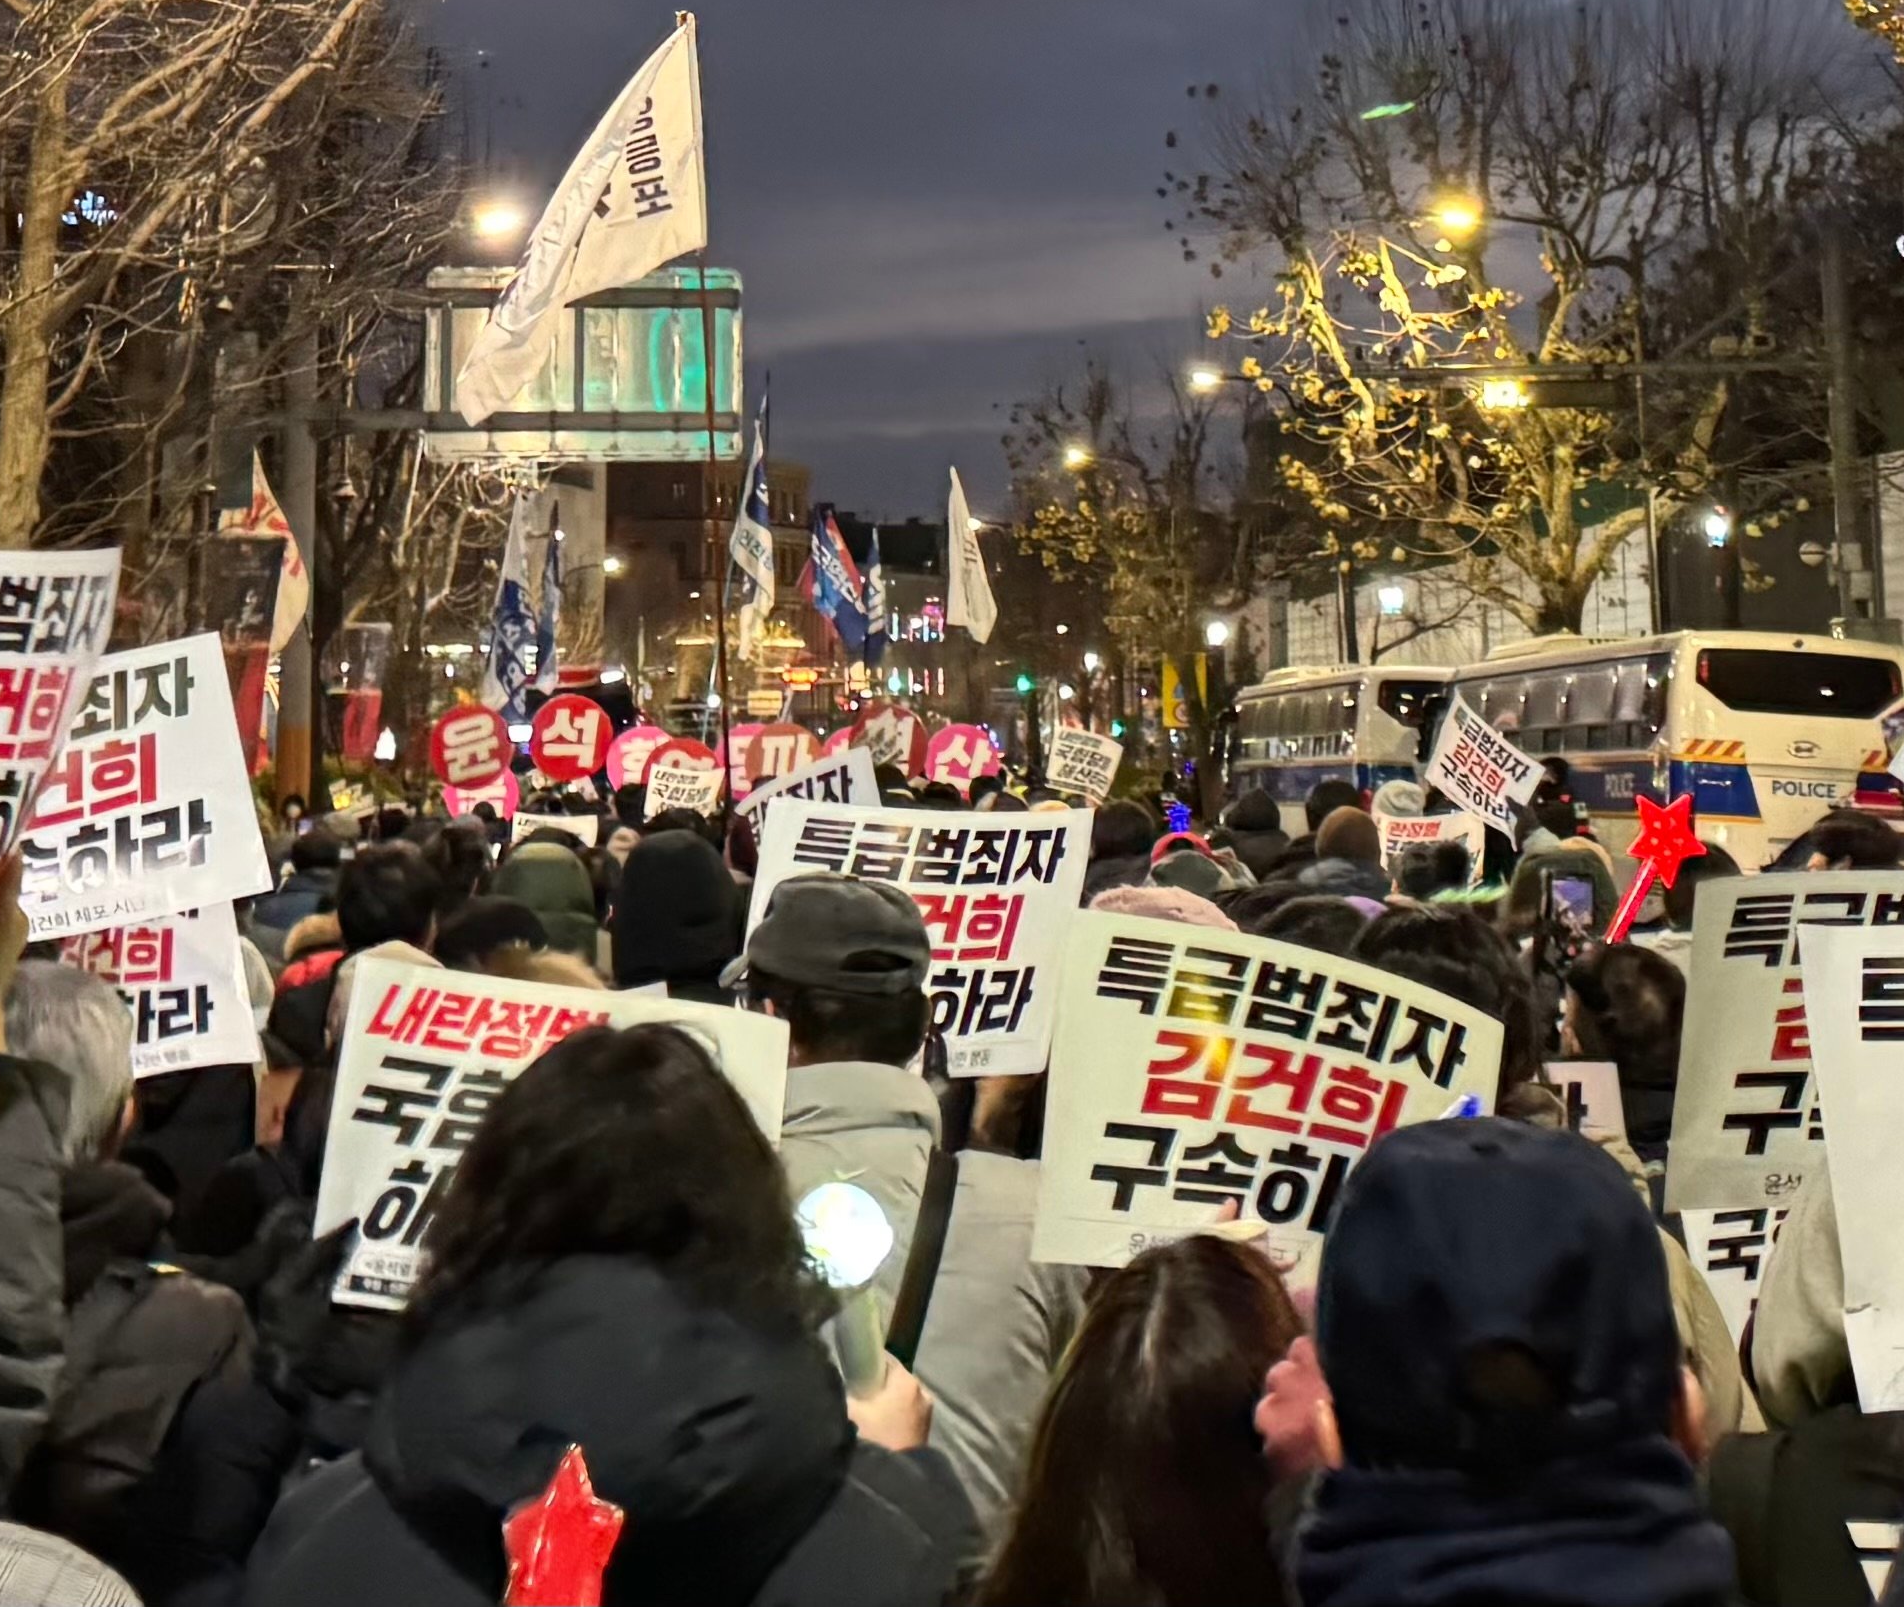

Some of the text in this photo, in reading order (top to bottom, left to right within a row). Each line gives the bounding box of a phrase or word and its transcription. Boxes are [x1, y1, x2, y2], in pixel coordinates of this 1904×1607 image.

[1772, 780, 1837, 799] POLICE
[793, 816, 1067, 887] 특급범죄자
[1097, 937, 1467, 1089] 특급범죄자
[1141, 1029, 1411, 1149] 김건희
[1089, 1121, 1351, 1234] 구속하
